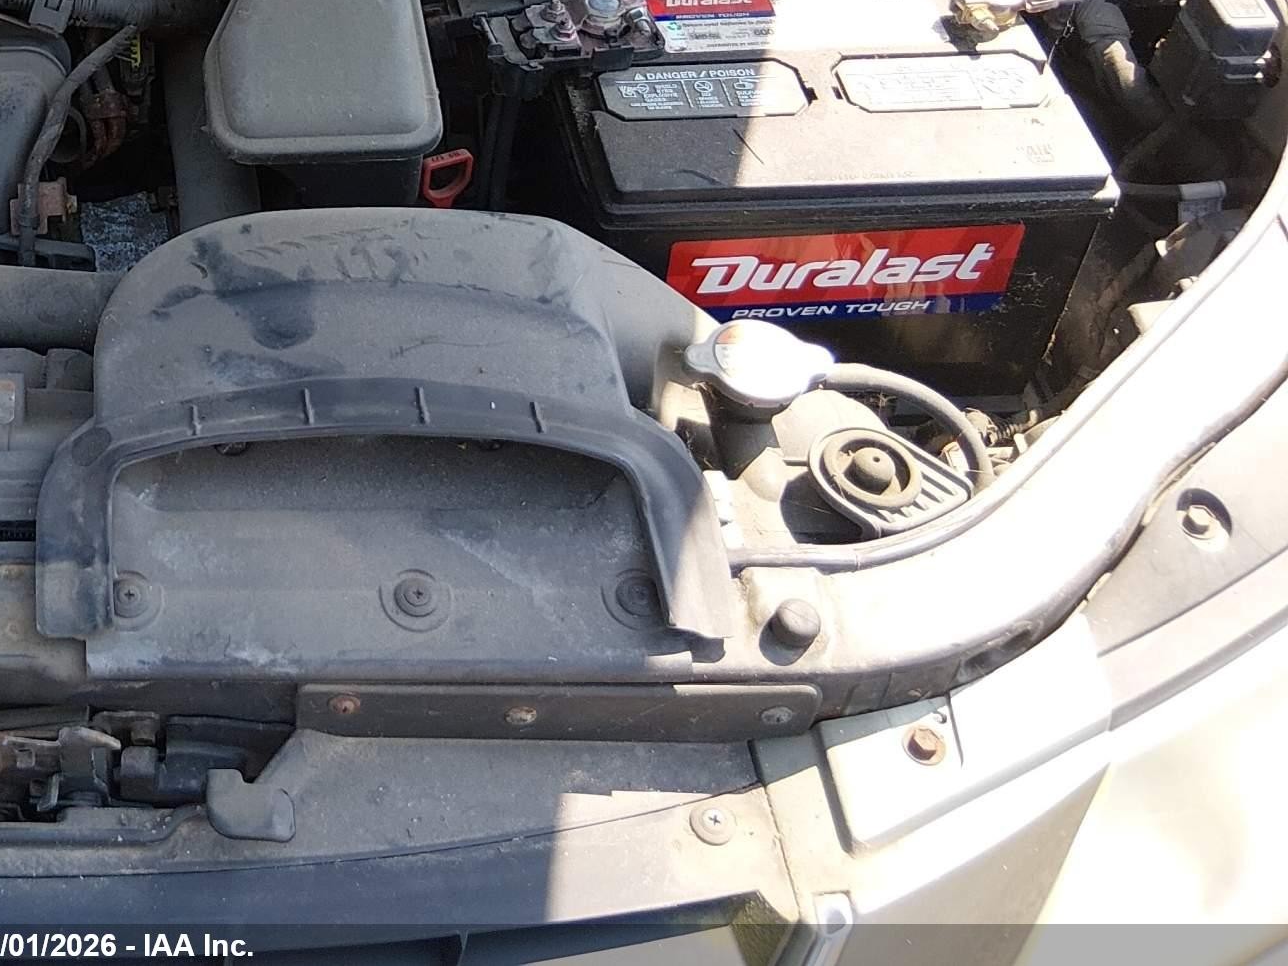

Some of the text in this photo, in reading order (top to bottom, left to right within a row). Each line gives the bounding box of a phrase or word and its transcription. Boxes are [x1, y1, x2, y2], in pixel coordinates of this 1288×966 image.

[646, 70, 697, 80] DANGER
[709, 68, 755, 78] POISON
[691, 242, 993, 295] Duralast
[731, 299, 931, 320] PROVEN TOUGH
